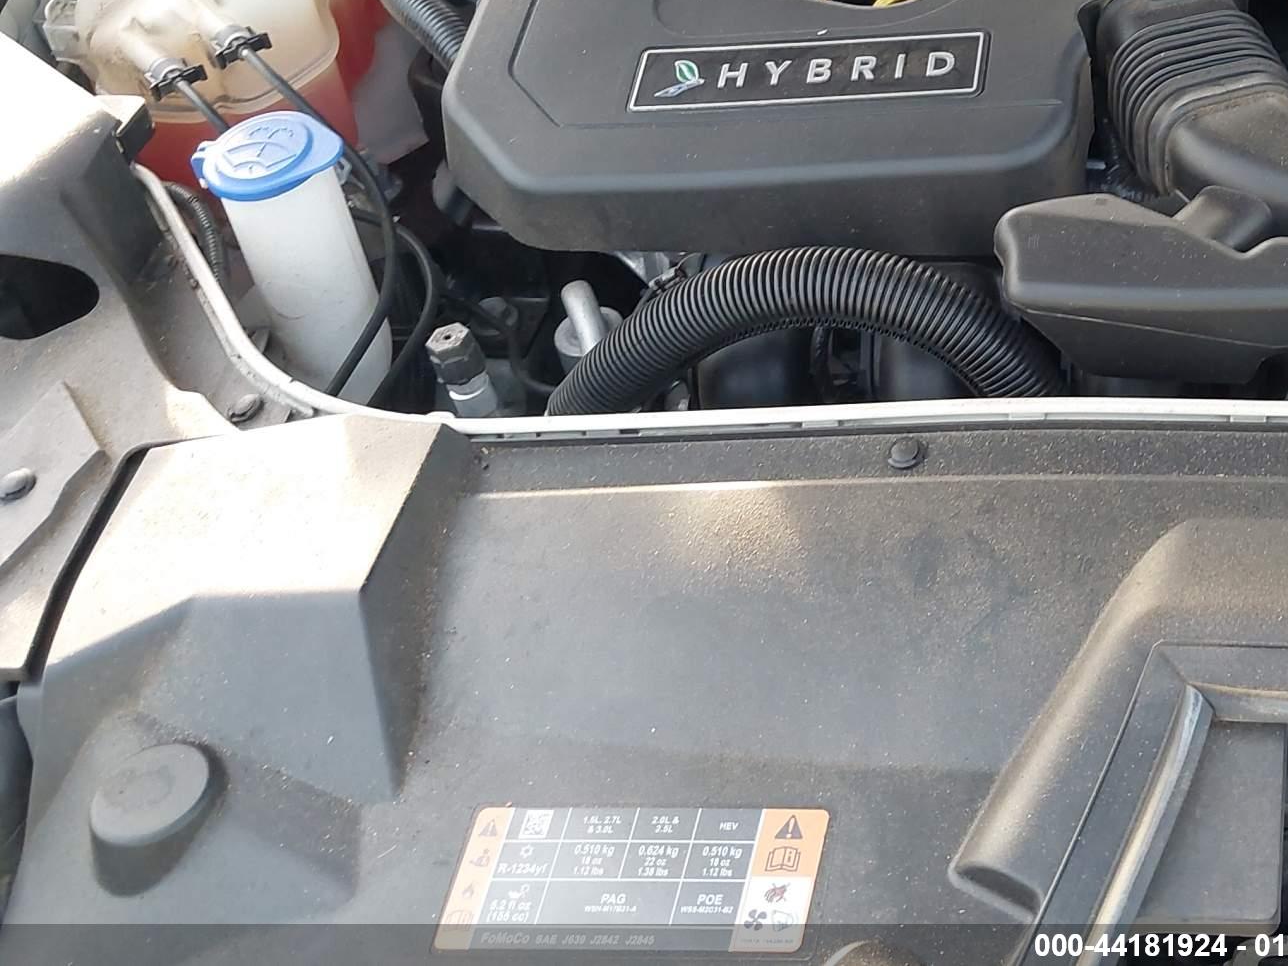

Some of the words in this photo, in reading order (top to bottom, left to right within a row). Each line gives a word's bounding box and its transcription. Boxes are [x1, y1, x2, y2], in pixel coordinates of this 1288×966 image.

[717, 50, 957, 89] HYBRID
[719, 822, 740, 831] HEV
[574, 844, 602, 855] 0.510
[602, 844, 616, 858] kg
[638, 845, 666, 857] 0.624
[666, 845, 680, 859] kg
[702, 846, 730, 857] 0.510
[730, 846, 743, 859] kg
[599, 893, 628, 905] PAG
[697, 894, 725, 906] POE
[481, 932, 531, 944] FoMoCo
